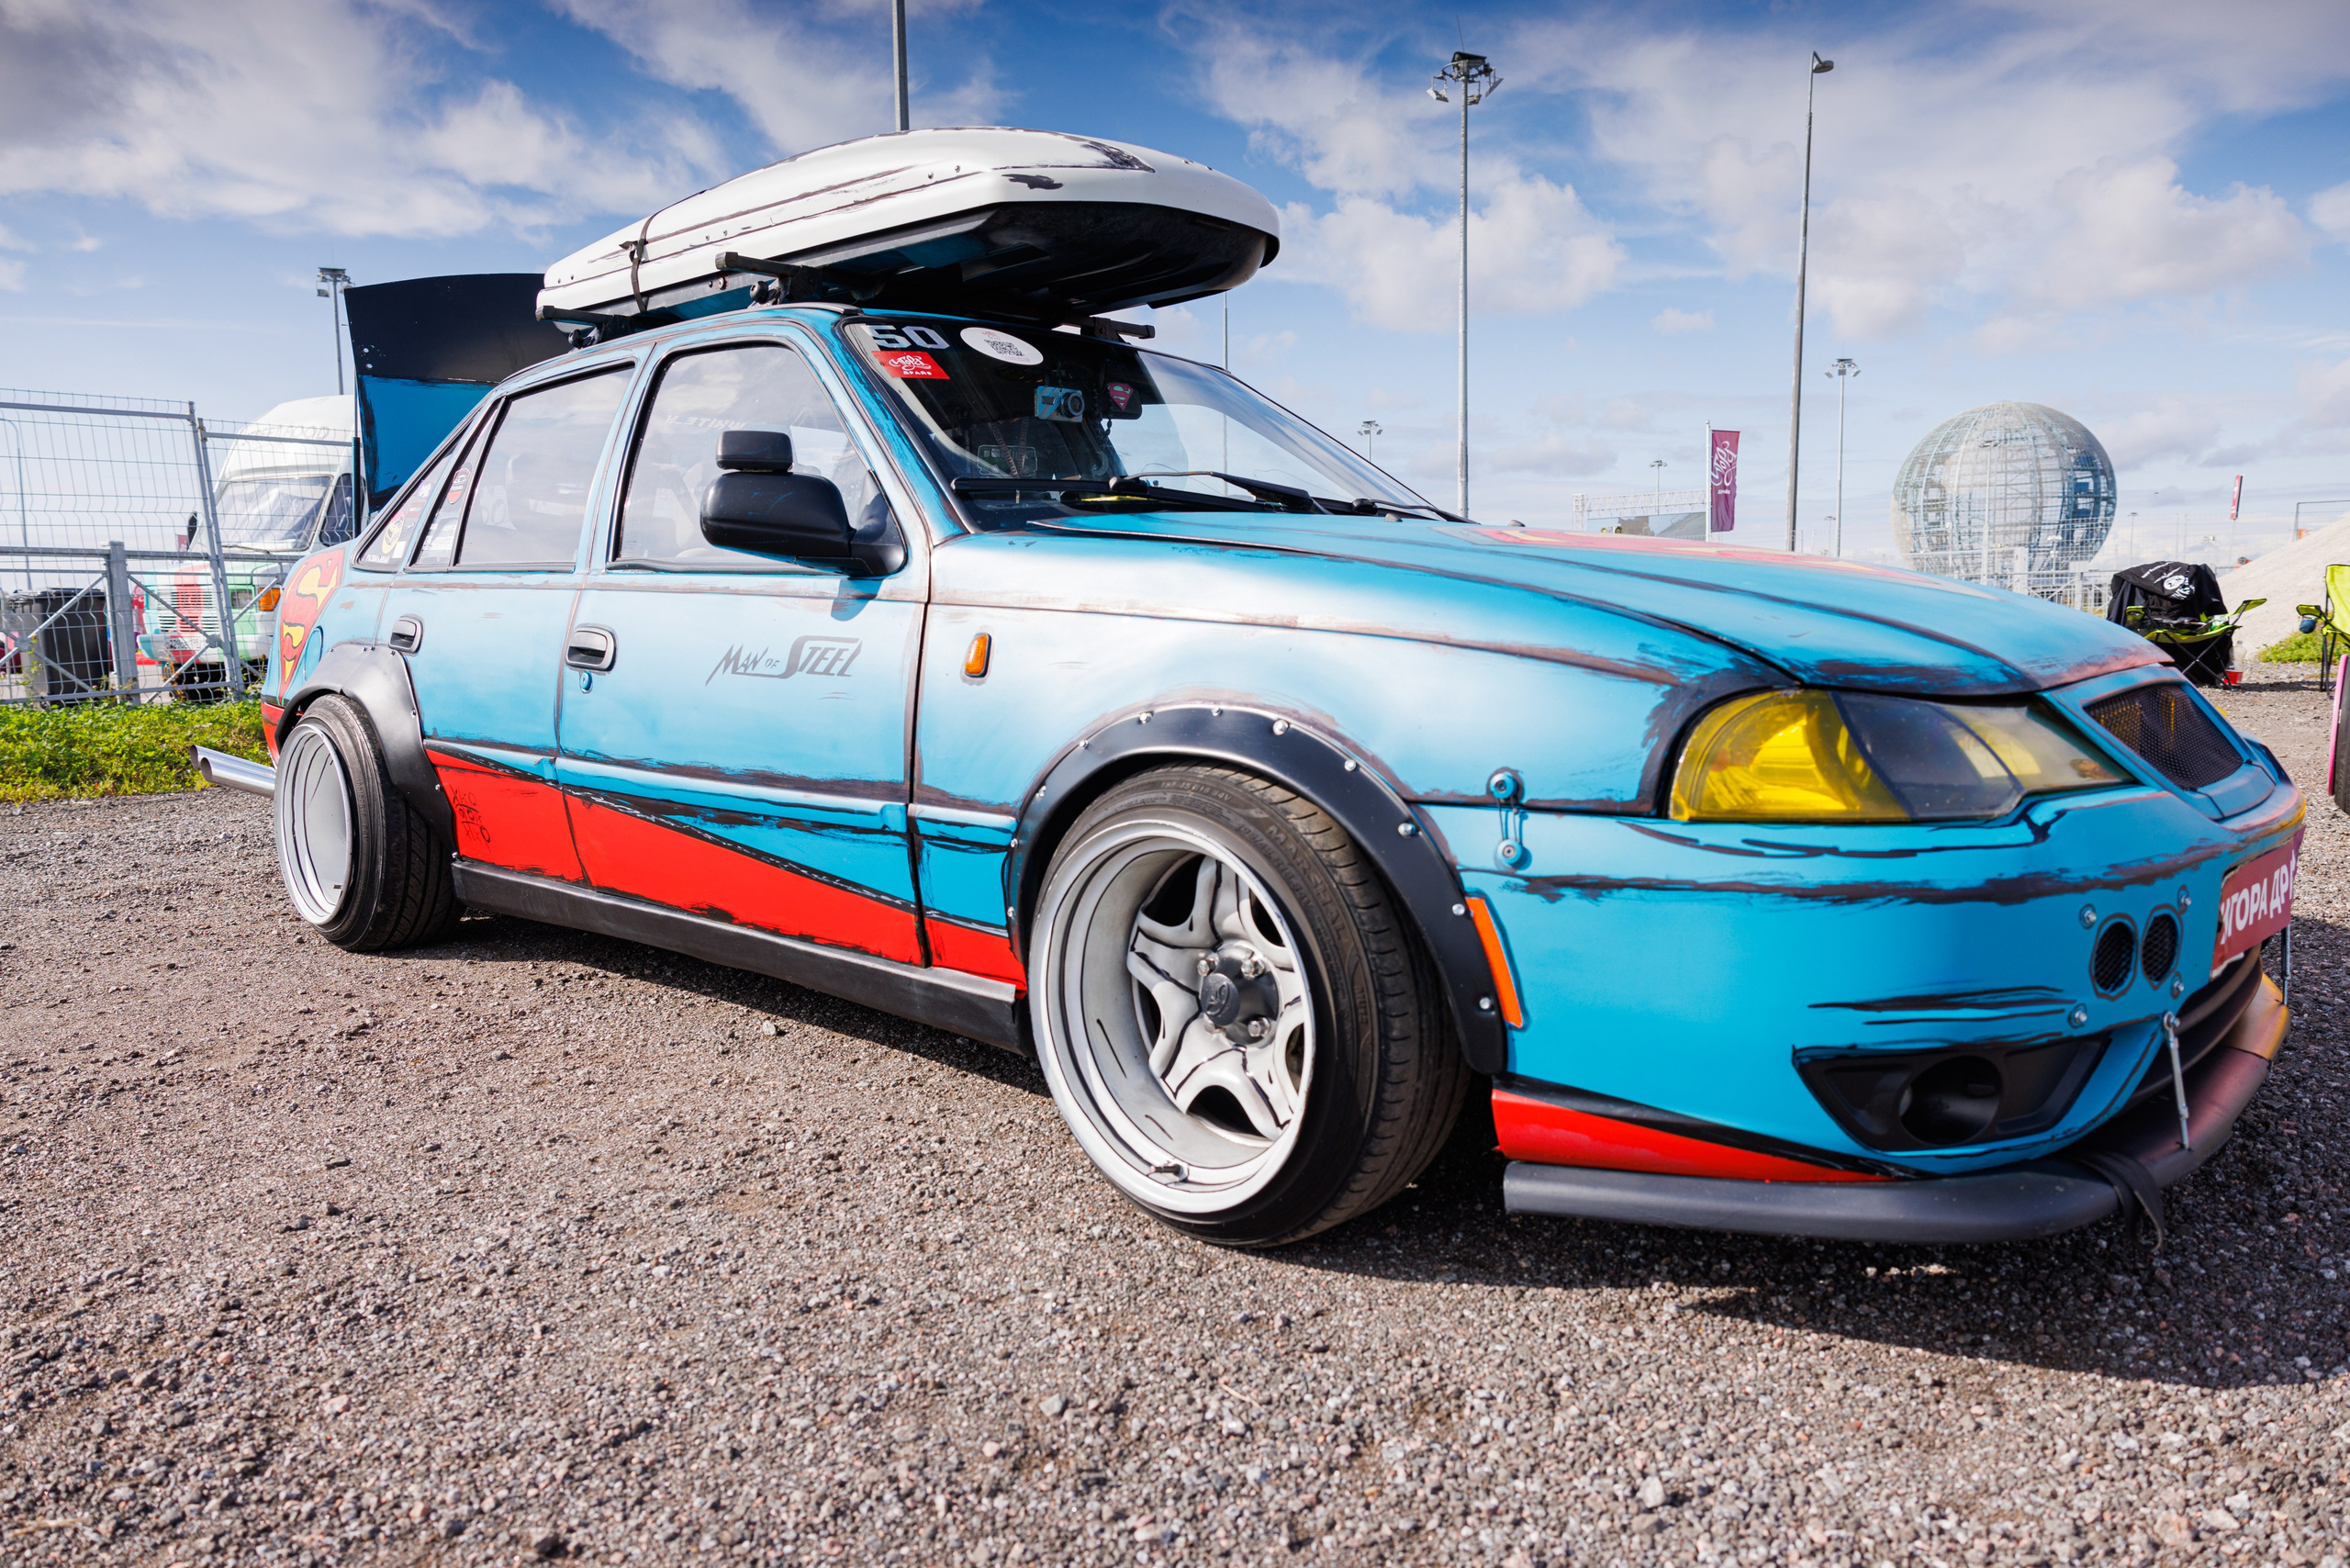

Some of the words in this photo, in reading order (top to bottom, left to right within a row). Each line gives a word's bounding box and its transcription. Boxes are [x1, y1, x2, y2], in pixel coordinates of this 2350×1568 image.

[867, 324, 950, 350] 50
[769, 634, 864, 680] STEEL
[1266, 824, 1346, 941] MARSHAL
